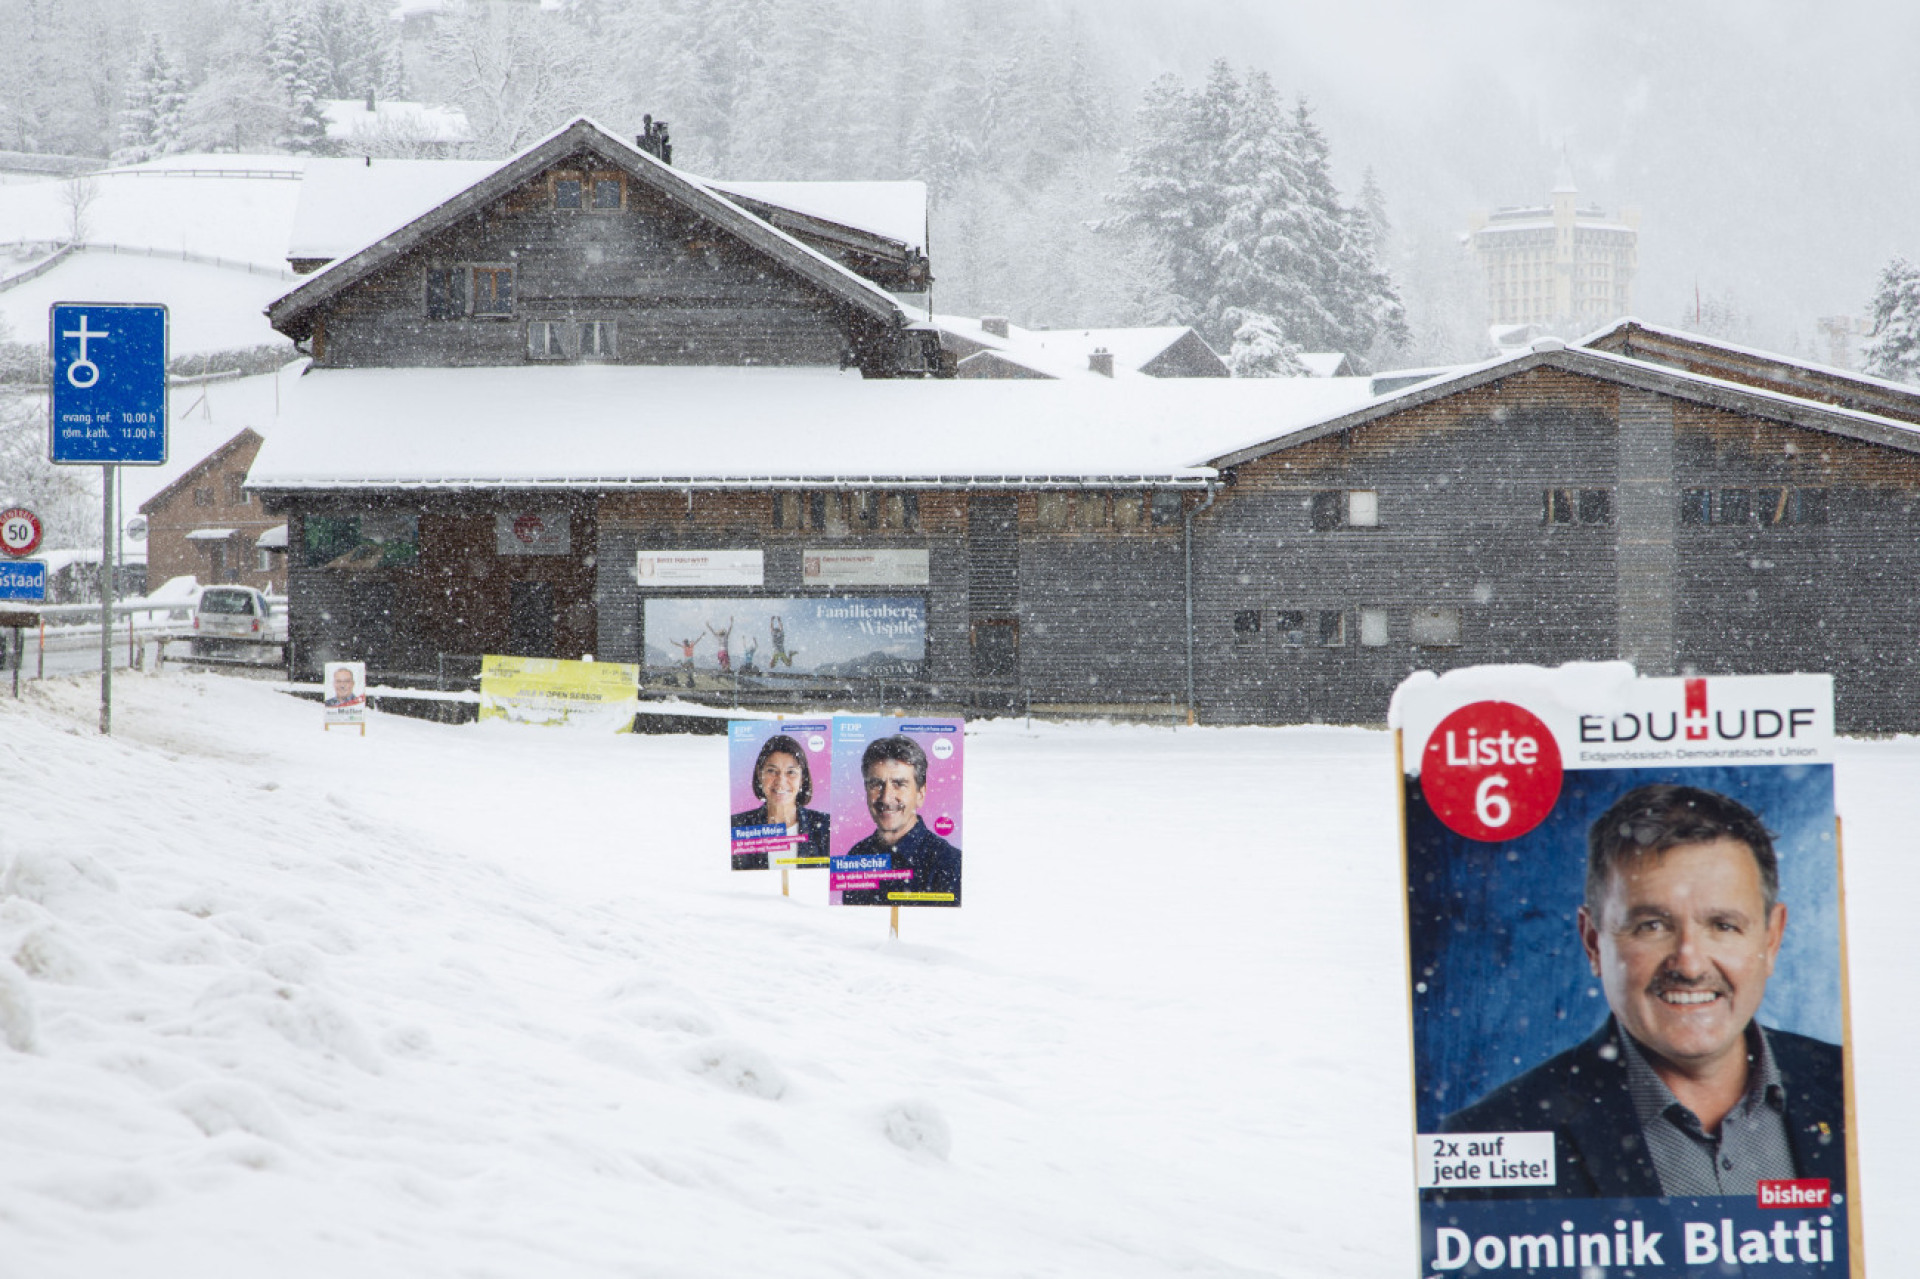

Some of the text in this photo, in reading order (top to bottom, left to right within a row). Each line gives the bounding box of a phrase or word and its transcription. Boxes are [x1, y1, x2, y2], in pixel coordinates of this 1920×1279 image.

[62, 412, 156, 424] evang. ref. 10.00 h
[62, 427, 156, 438] röm. kath. 11.00 h
[8, 525, 28, 541] 50
[816, 603, 918, 621] Familienberg
[859, 620, 917, 638] Wispile
[840, 723, 862, 732] FDP
[1579, 708, 1815, 743] EDU UDF
[1446, 728, 1538, 766] Liste
[1580, 746, 1818, 762] Eidgenössisch-Demokratische Union
[1475, 775, 1512, 828] 6
[836, 859, 860, 870] Hans
[860, 858, 887, 869] Schär
[1433, 1136, 1505, 1157] 2x auf
[1432, 1158, 1549, 1185] jede Liste!
[1761, 1184, 1827, 1205] bisher
[1435, 1215, 1834, 1270] Dominik Blatti
